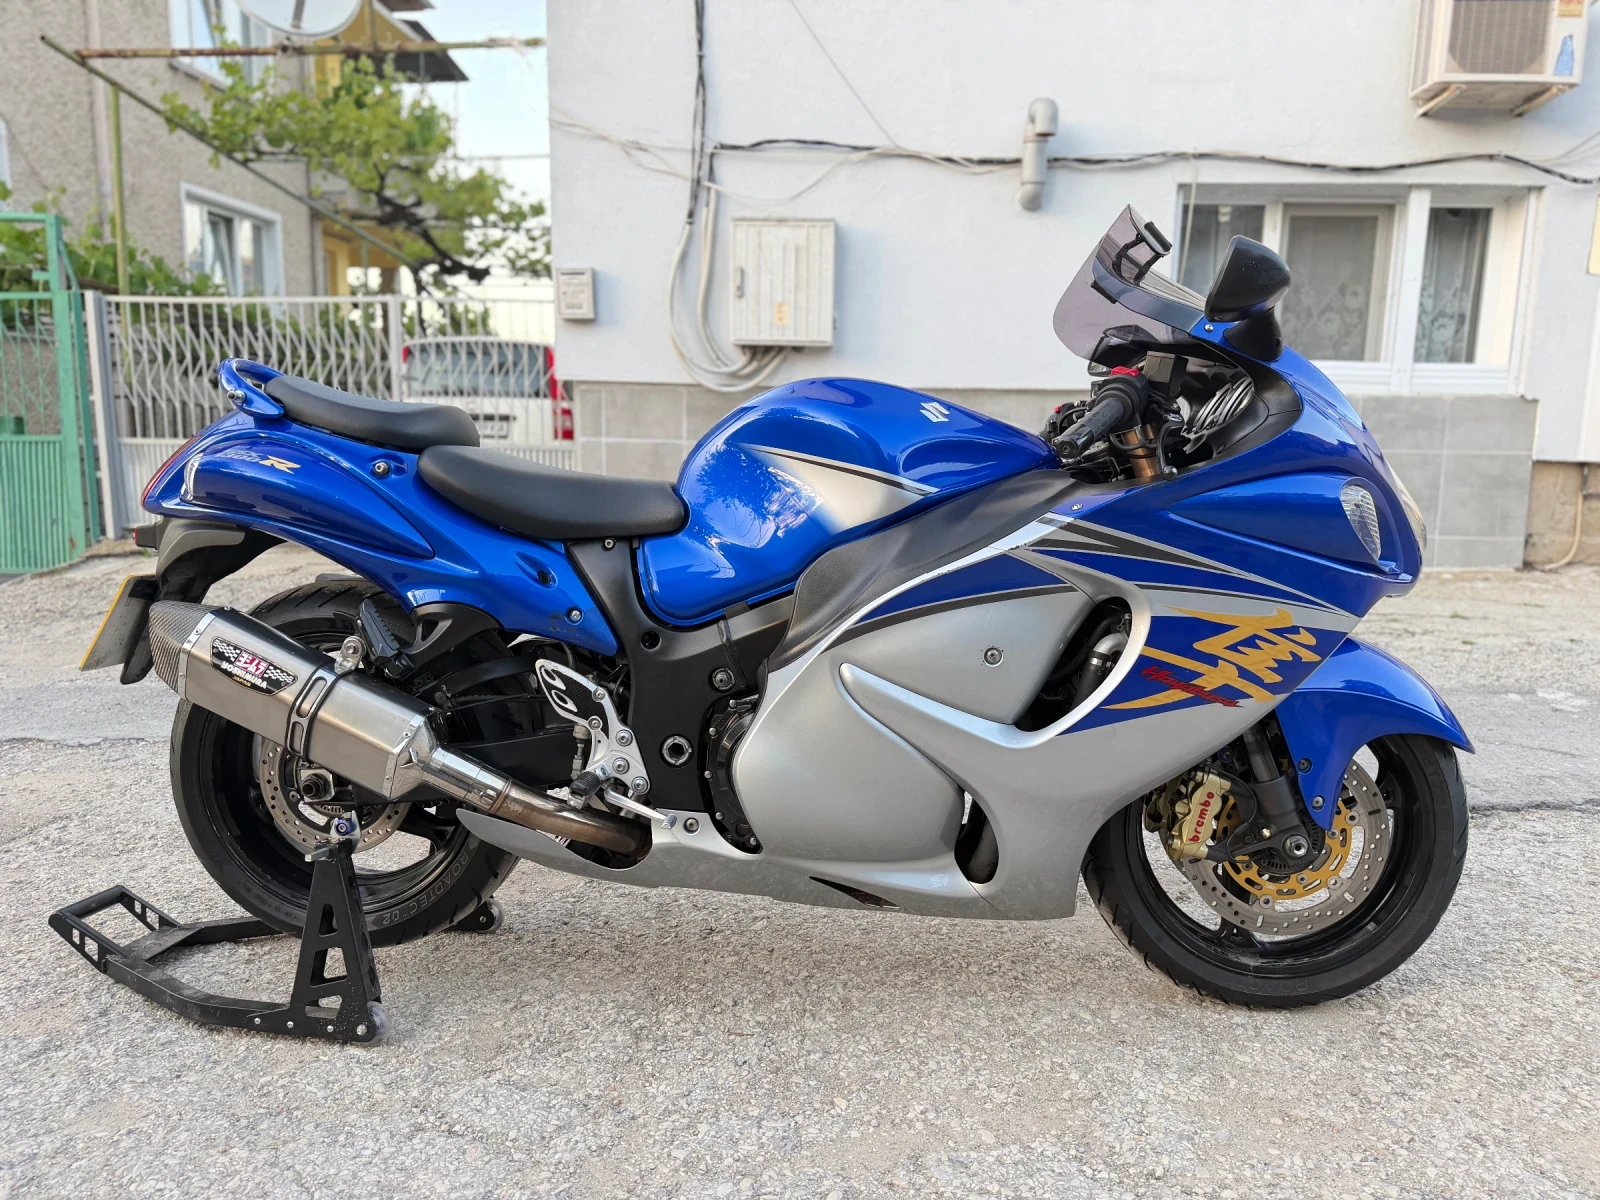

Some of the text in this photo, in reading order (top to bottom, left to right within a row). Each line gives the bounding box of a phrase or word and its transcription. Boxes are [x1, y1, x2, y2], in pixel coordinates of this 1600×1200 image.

[220, 660, 268, 689] YOSHIMURA
[1188, 791, 1215, 843] brembo
[382, 850, 469, 925] ROADTEC 02
